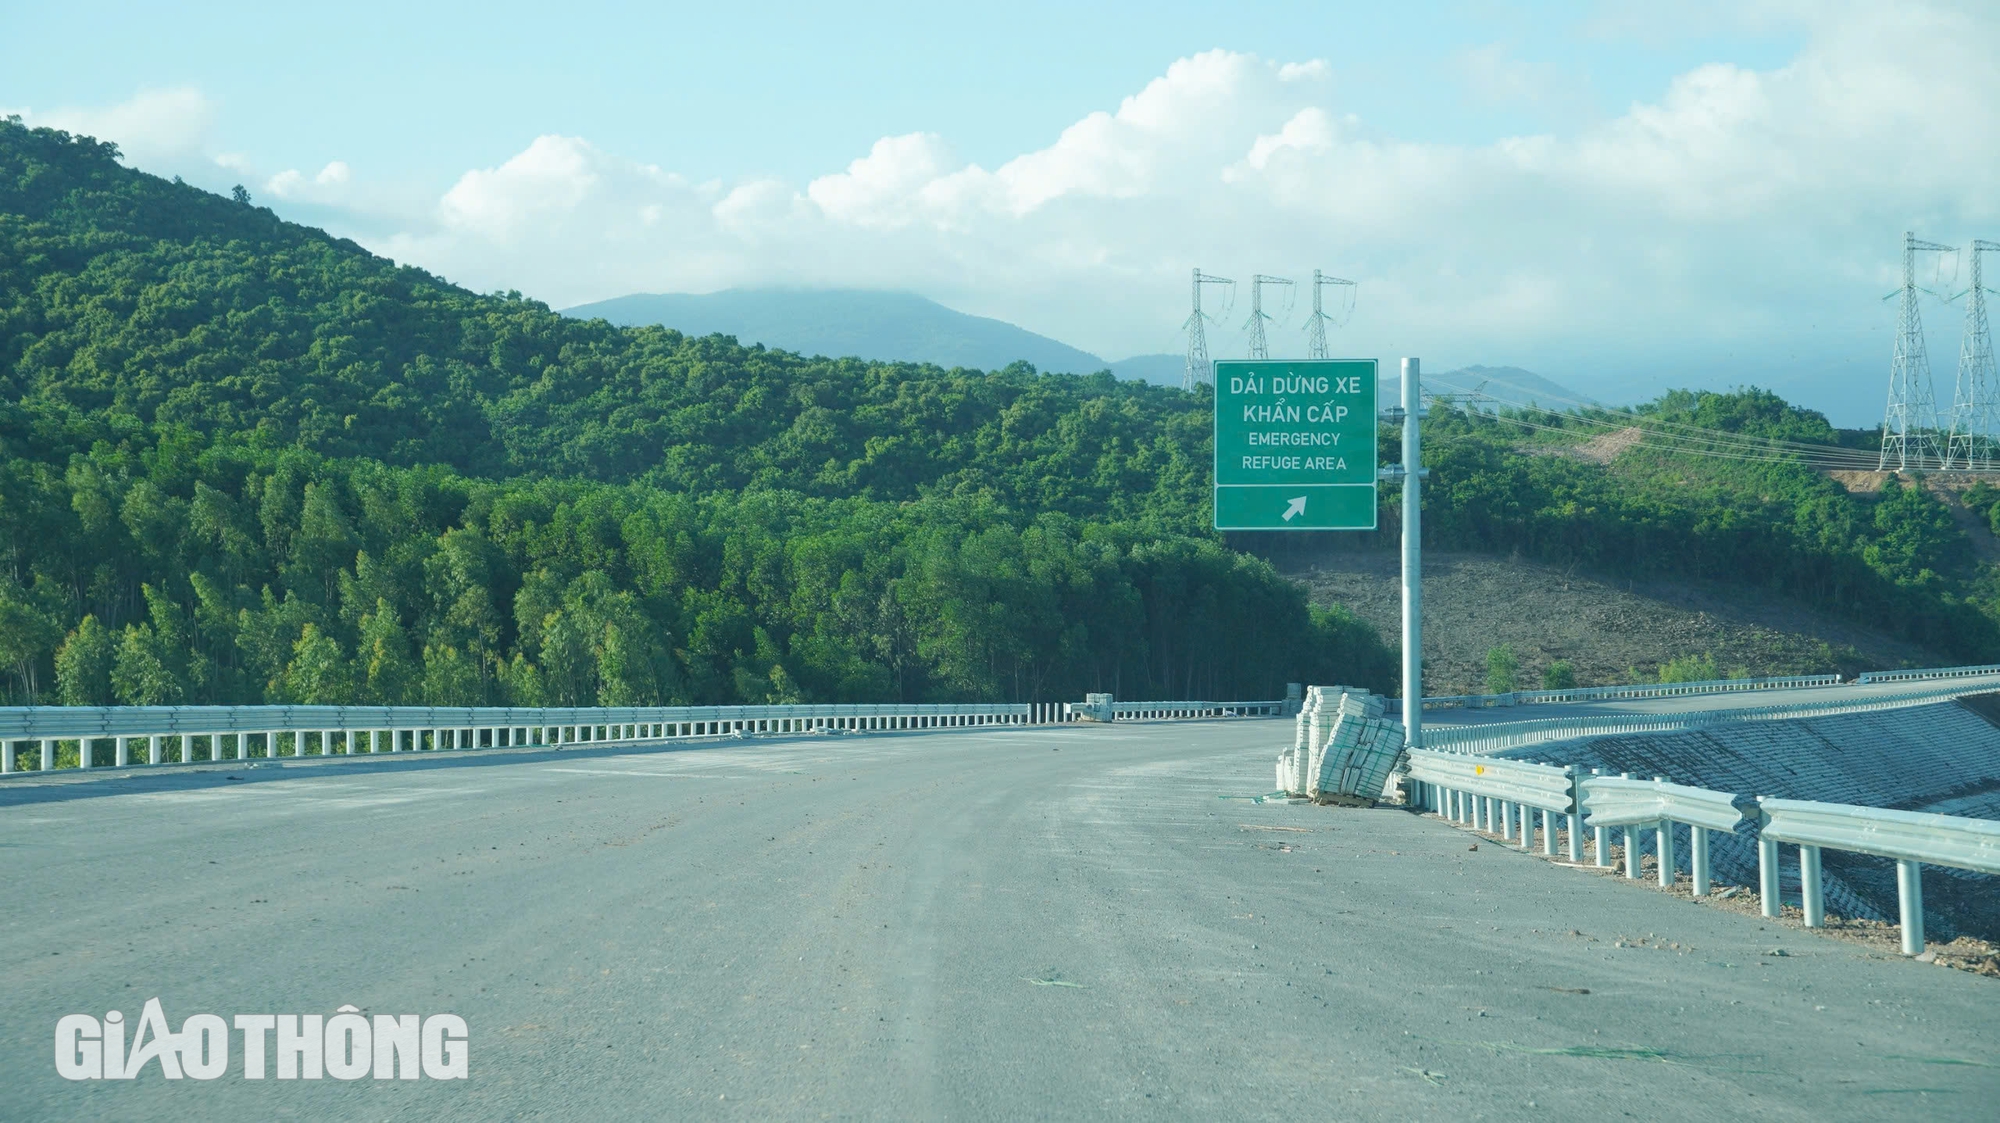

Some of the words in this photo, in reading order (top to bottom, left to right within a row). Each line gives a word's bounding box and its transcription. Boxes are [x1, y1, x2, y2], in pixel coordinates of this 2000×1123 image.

[1230, 372, 1264, 395] DẢI
[1272, 372, 1329, 394] DỪNG
[1335, 376, 1361, 394] XE
[1243, 398, 1300, 423] KHẨN
[1307, 399, 1349, 423] CẤP
[1248, 432, 1341, 446] EMERGENCY
[1242, 456, 1300, 470] REFUGE
[1304, 457, 1347, 470] AREA
